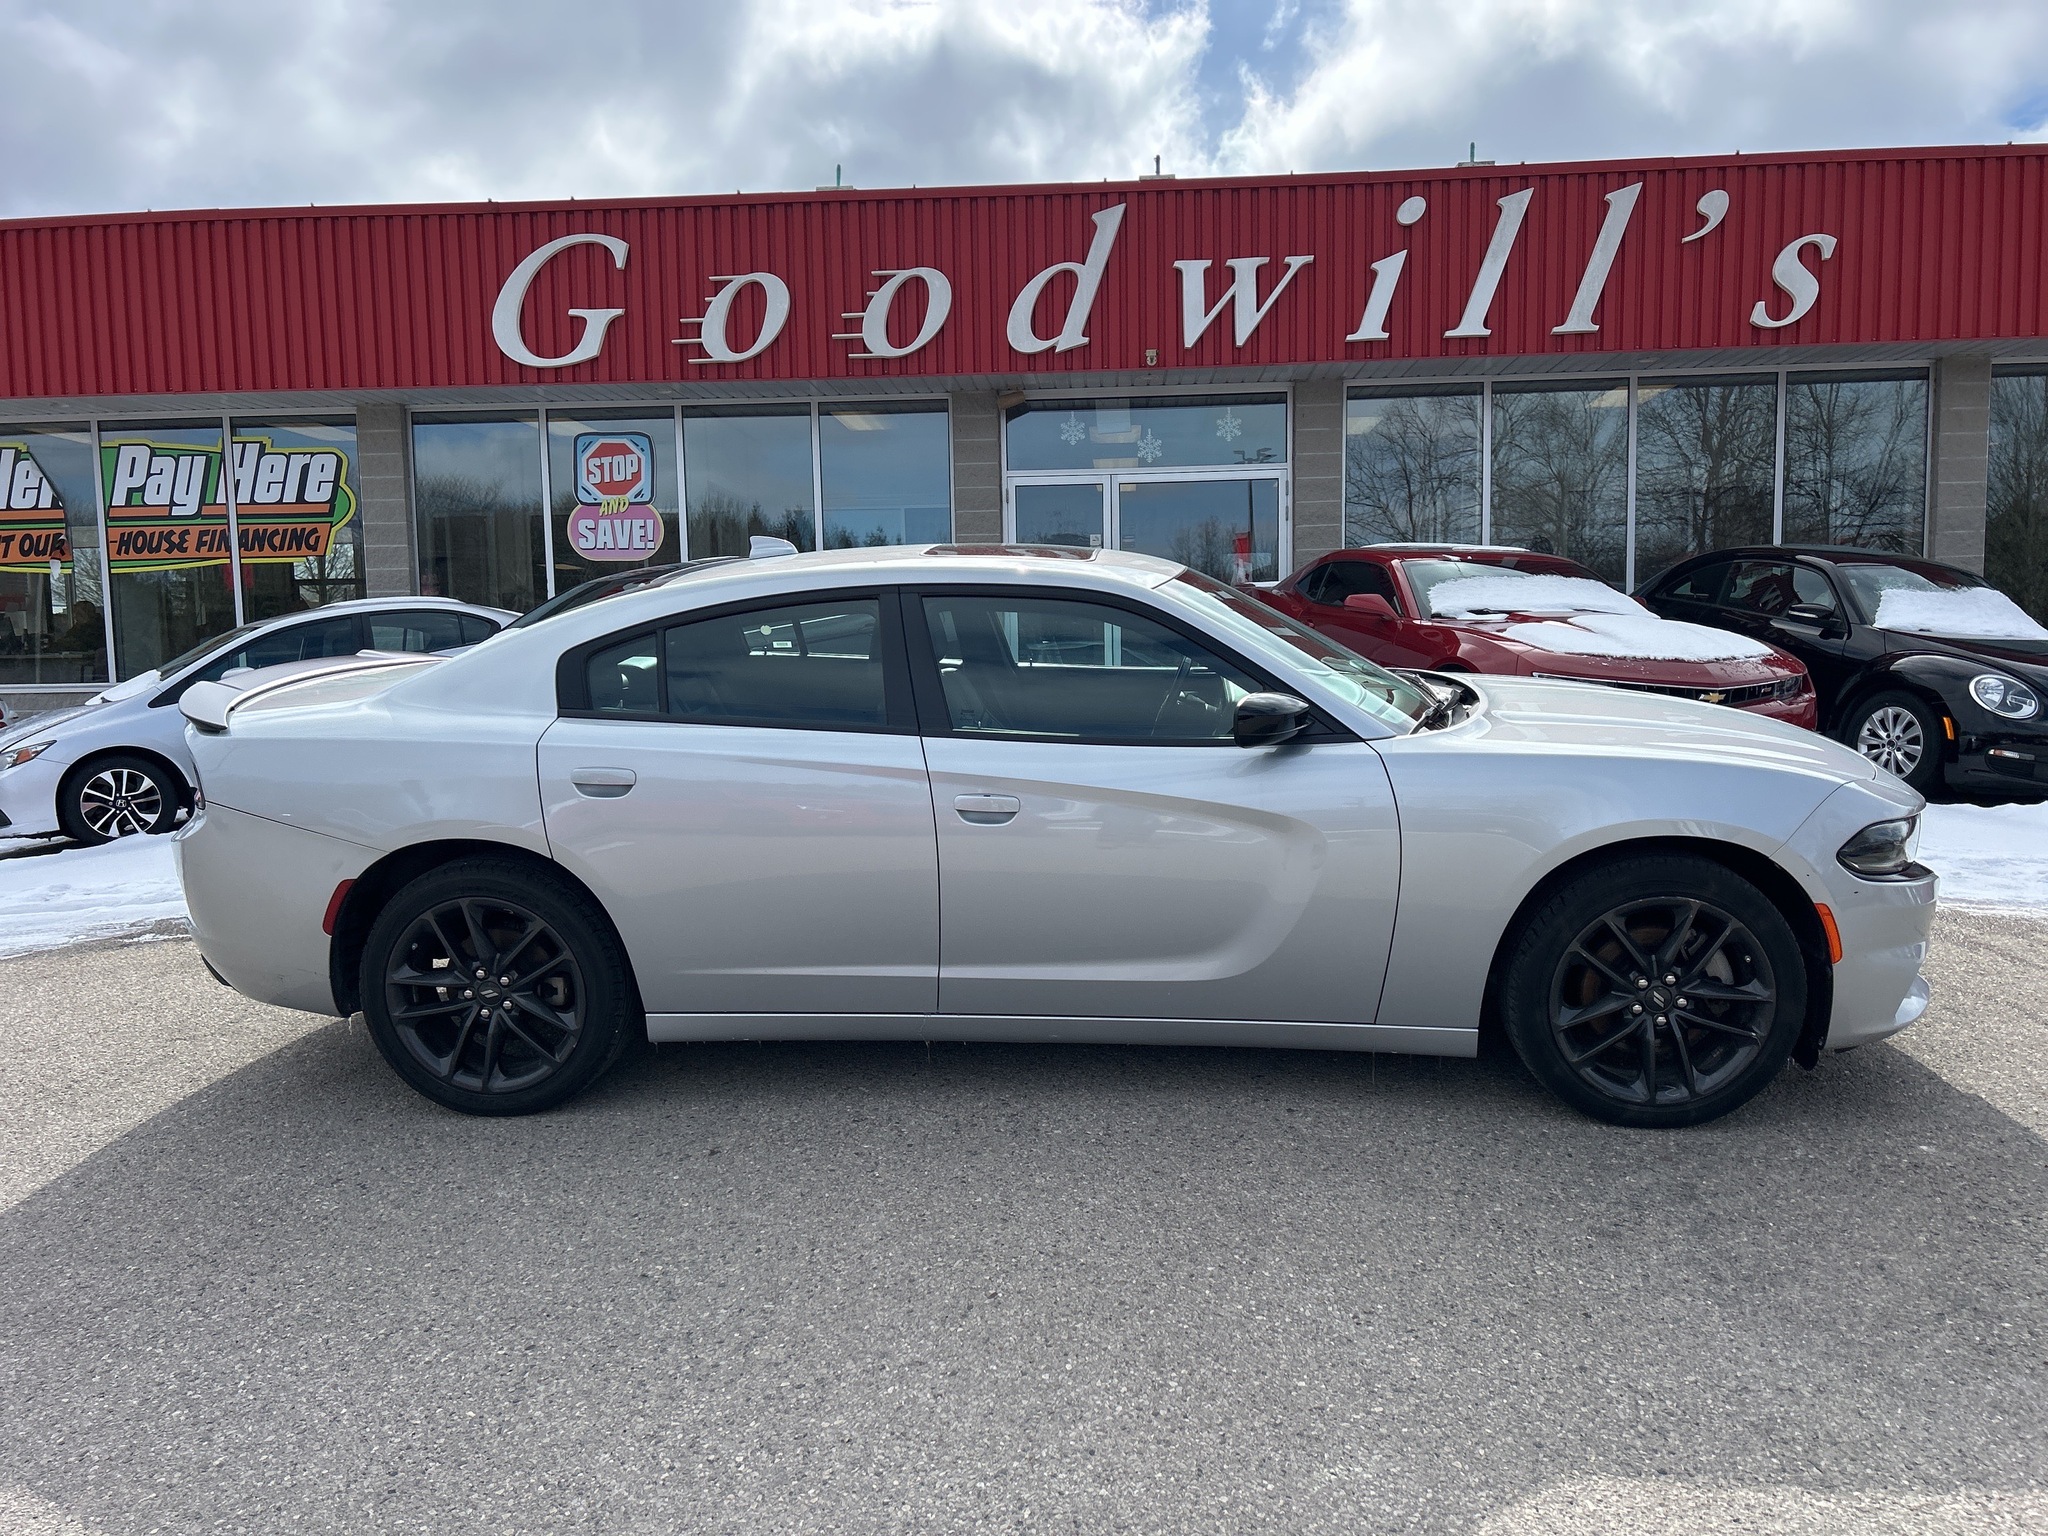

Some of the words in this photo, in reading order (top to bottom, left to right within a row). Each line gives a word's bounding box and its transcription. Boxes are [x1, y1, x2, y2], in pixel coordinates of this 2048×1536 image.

[492, 182, 1837, 368] Goodwill's
[111, 445, 207, 516] Pay
[216, 443, 338, 504] Here
[588, 453, 639, 484] STOP
[599, 495, 630, 516] AND
[19, 532, 66, 557] OUR
[195, 527, 321, 554] FINANCING
[577, 518, 656, 550] SAVE!
